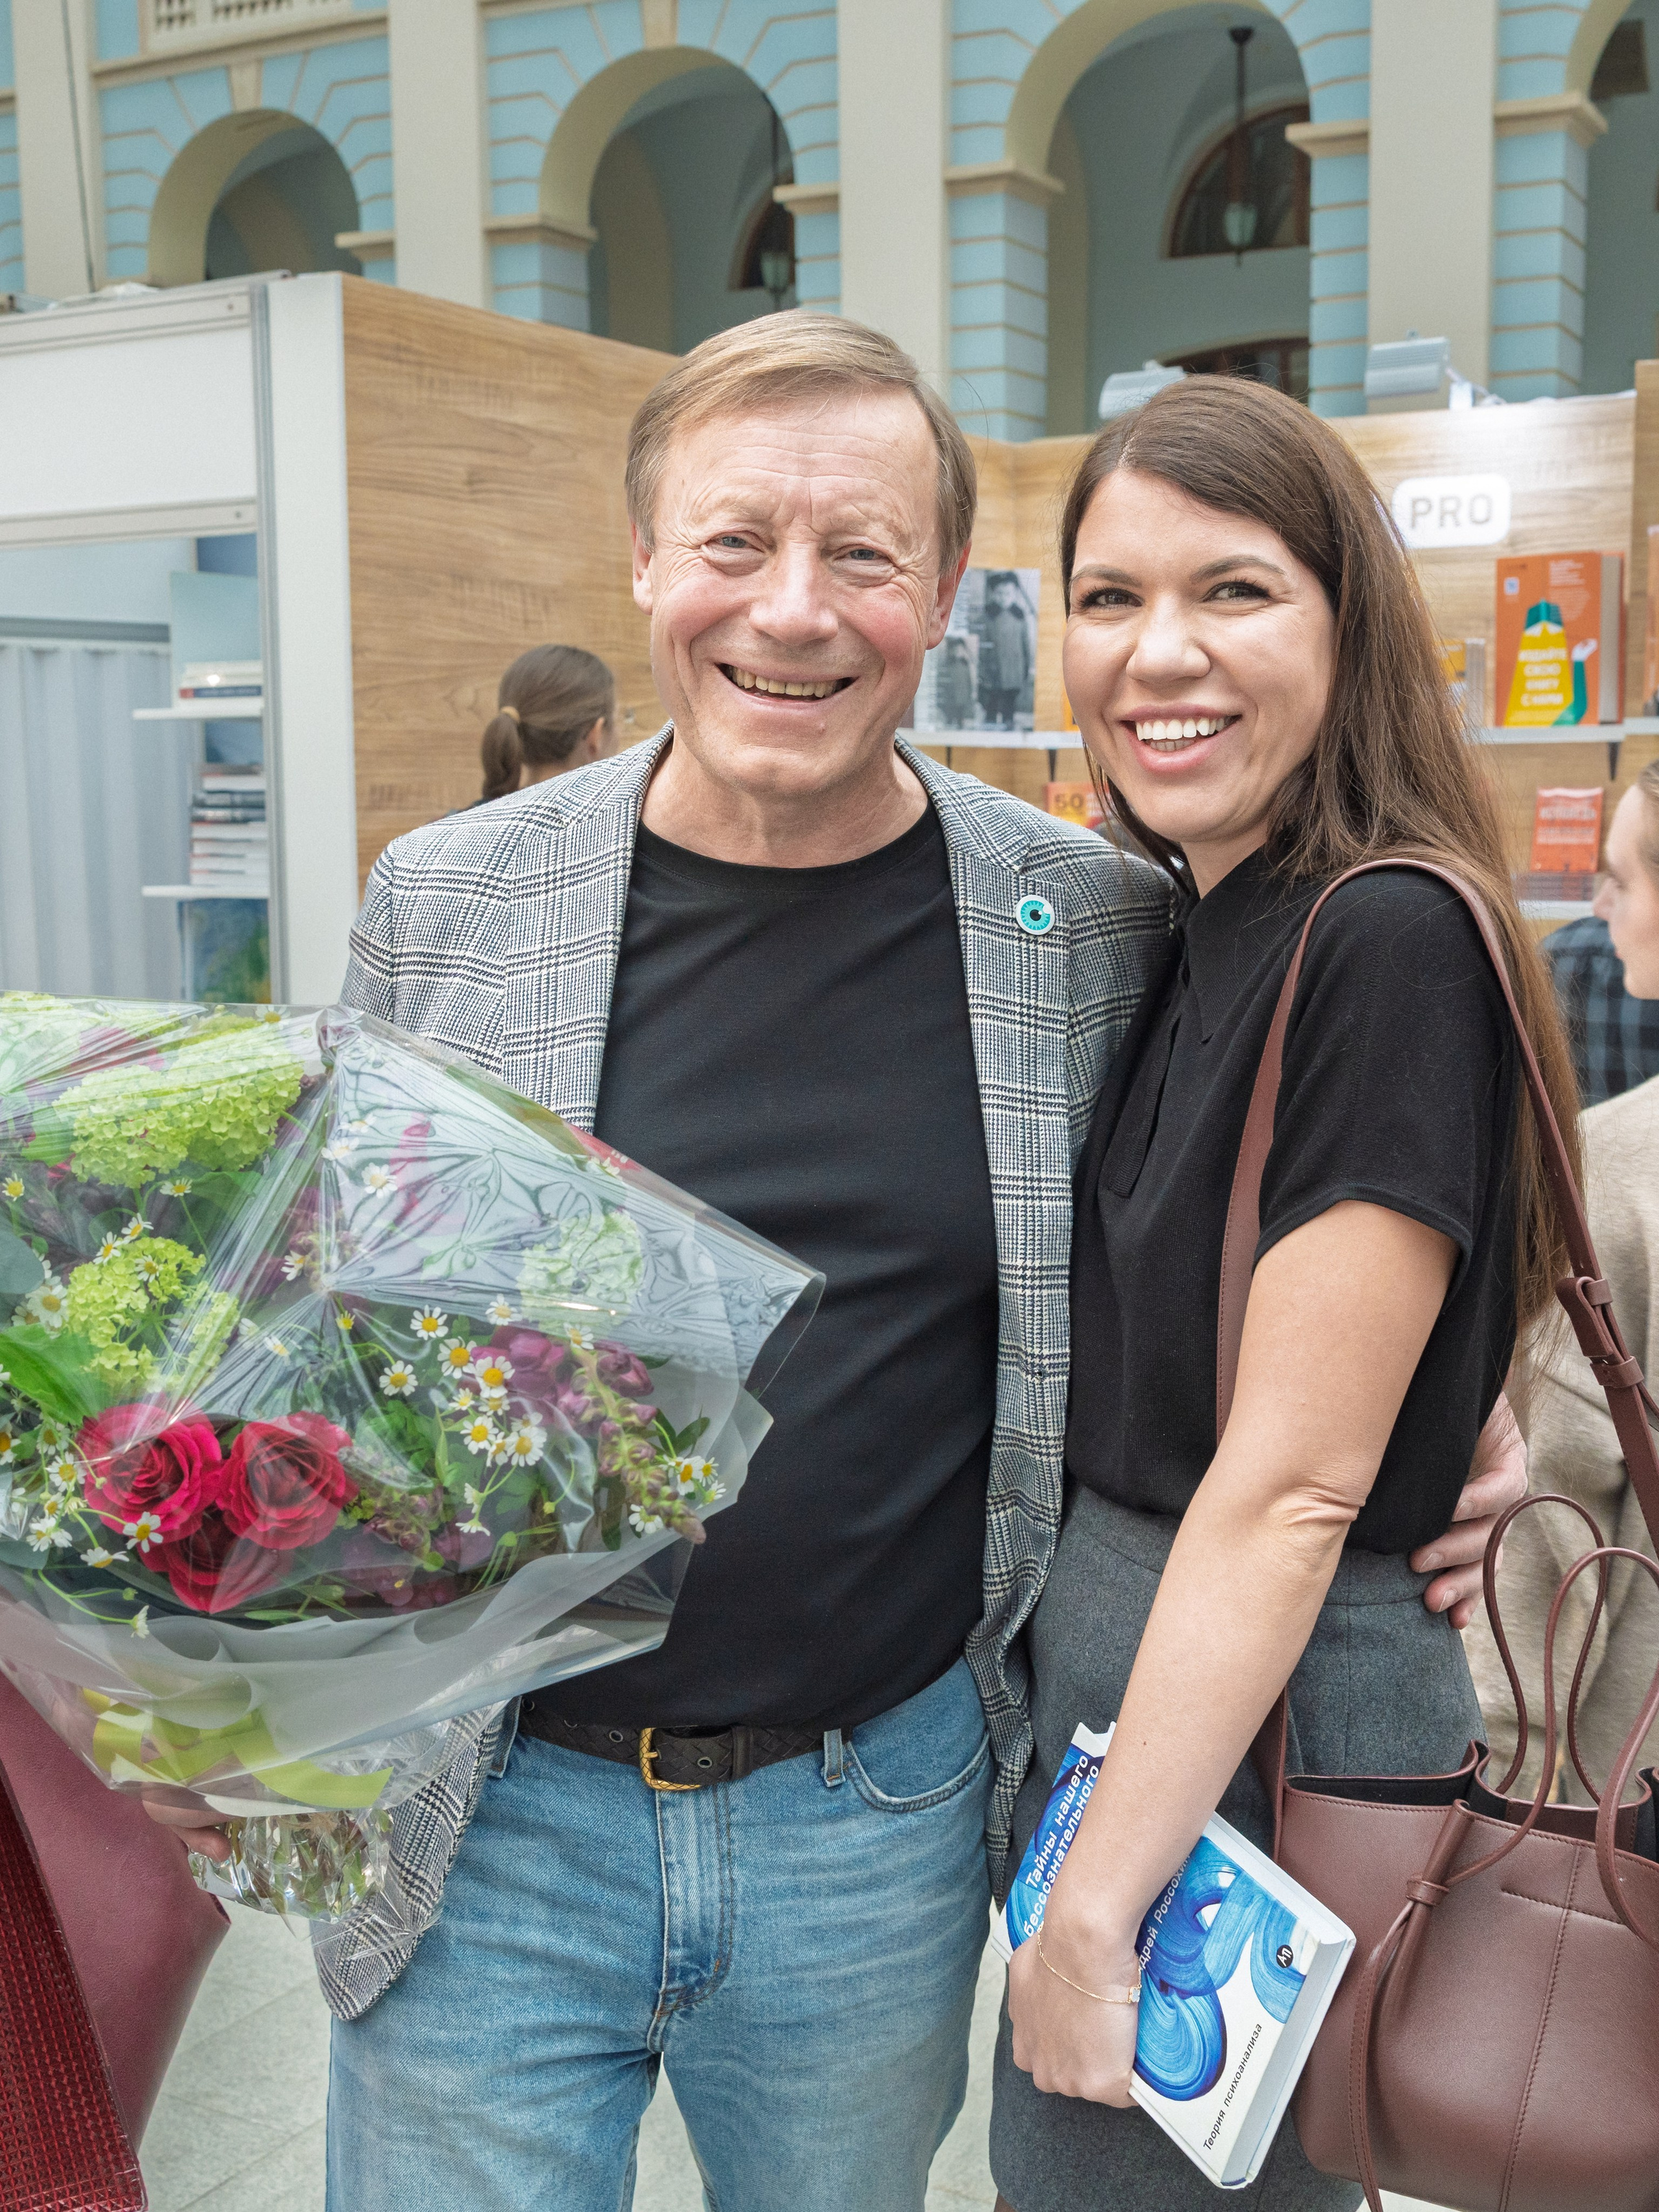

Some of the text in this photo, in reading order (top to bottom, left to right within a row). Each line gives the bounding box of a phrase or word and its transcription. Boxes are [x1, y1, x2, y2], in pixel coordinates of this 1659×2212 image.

[1410, 493, 1493, 530] PRO
[1054, 793, 1085, 810] 50
[1023, 1765, 1099, 1937] бессознательного
[1026, 1755, 1089, 1888] Тайны нашего
[1139, 1926, 1158, 1970] дрей
[1203, 2023, 1262, 2150] Теория психоанализа
